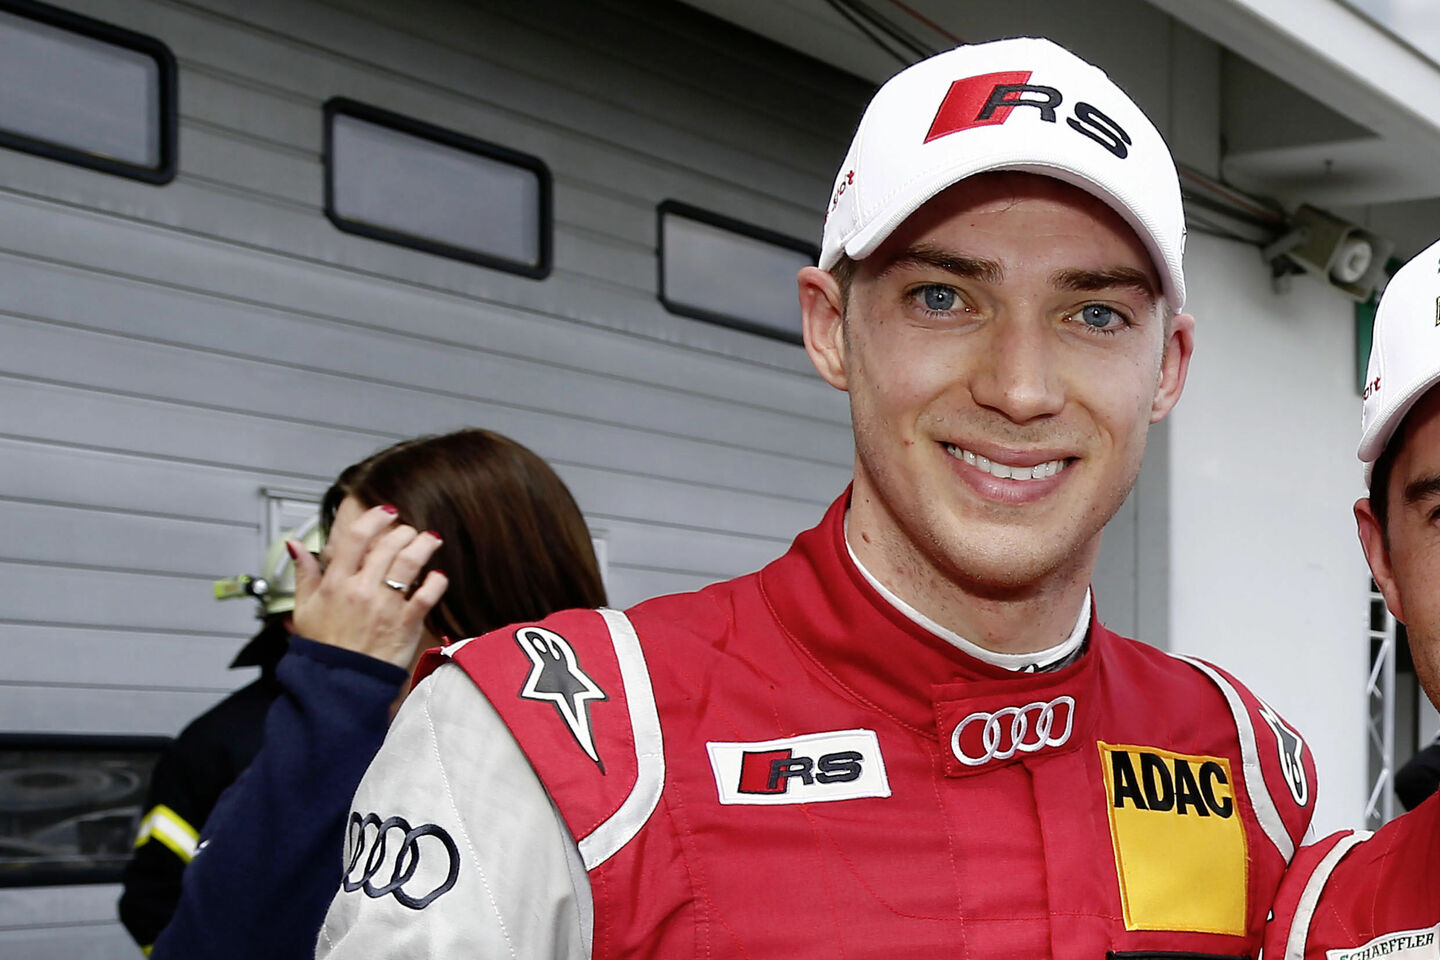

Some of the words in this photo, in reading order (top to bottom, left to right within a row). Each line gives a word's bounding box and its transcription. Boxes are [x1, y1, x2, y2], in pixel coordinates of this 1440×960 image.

[973, 83, 1133, 160] RS
[767, 750, 864, 790] RS
[1110, 750, 1233, 820] ADAC
